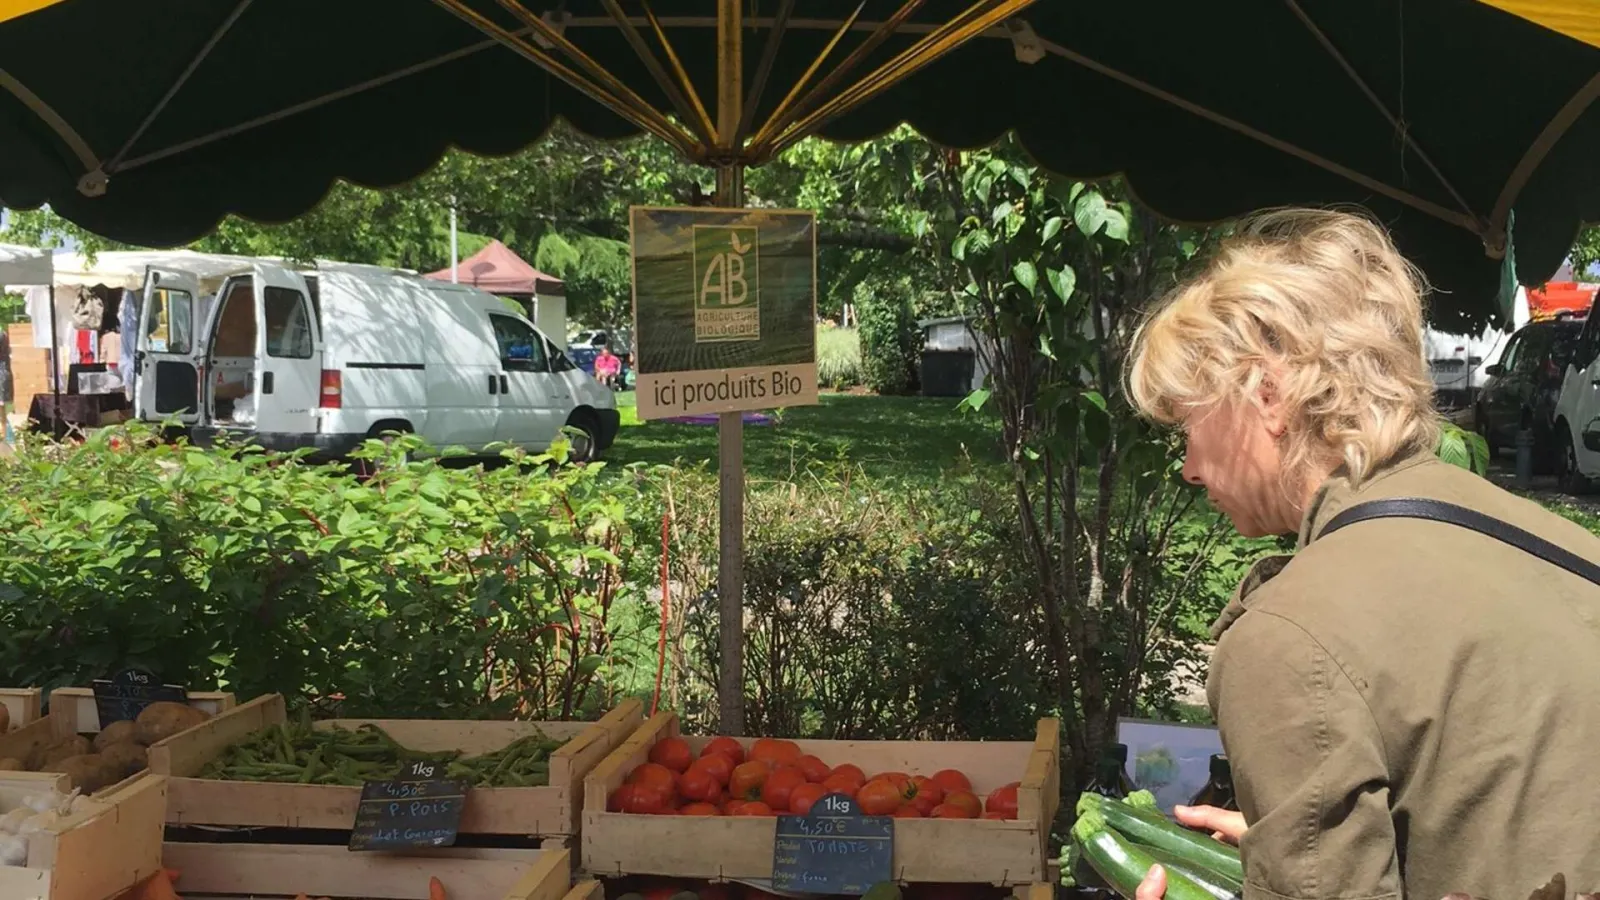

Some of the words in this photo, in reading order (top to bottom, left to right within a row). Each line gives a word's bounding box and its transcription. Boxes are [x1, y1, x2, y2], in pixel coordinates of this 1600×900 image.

[700, 252, 748, 305] AB
[697, 311, 758, 322] AGRICULTURE
[696, 323, 758, 335] BIOLOGIQUE
[654, 379, 676, 406] ici
[683, 372, 767, 411] produits
[772, 370, 802, 396] Bio
[126, 670, 149, 684] 1kg
[411, 761, 435, 778] 1kg
[824, 795, 850, 813] 1kg
